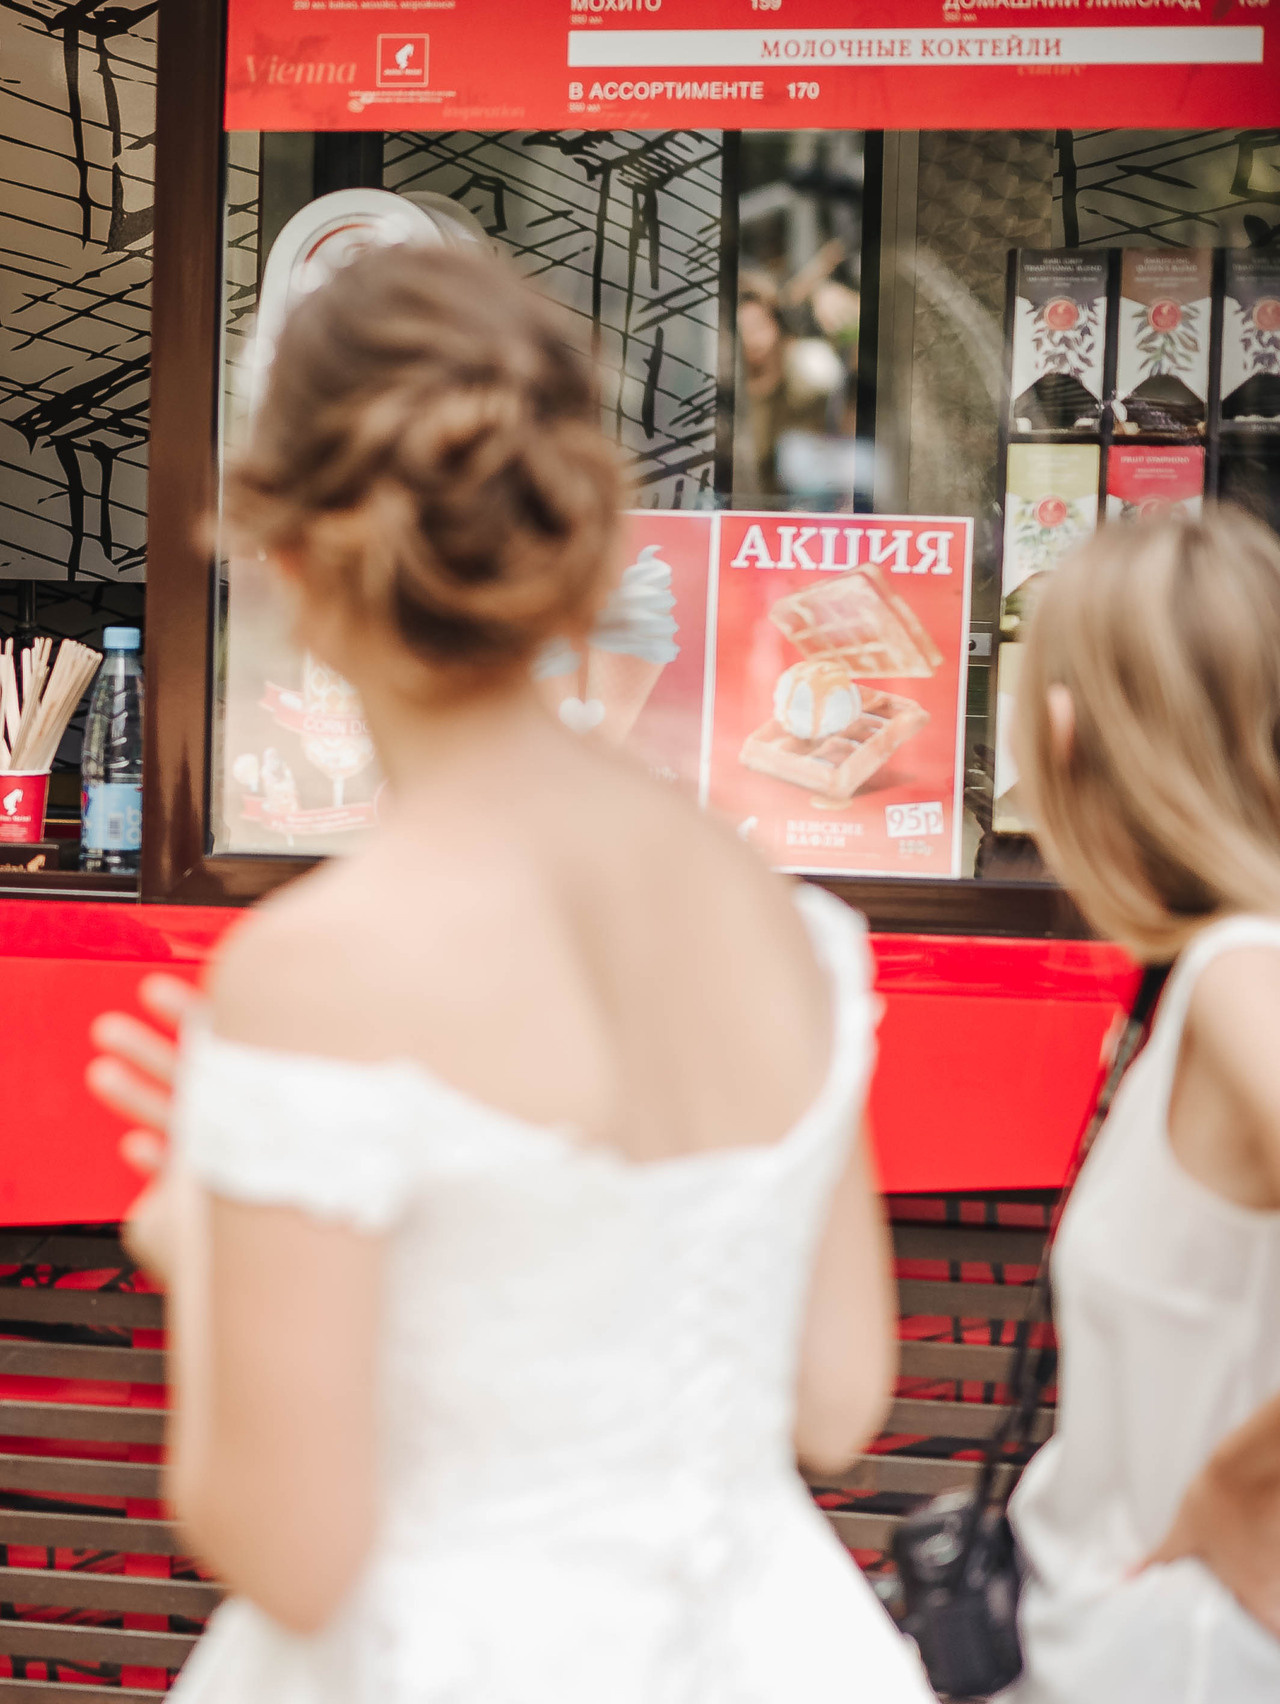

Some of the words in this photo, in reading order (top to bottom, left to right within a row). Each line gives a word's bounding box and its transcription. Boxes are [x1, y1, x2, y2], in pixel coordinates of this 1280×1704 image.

[760, 39, 912, 59] МОЛОЧНЫЕ
[920, 34, 1063, 57] КОКТЕЙЛИ
[245, 54, 357, 84] Vienna
[568, 82, 584, 100] В
[588, 80, 765, 100] АССОРТИМЕНТЕ
[787, 81, 820, 100] 170
[730, 524, 954, 575] АКЦИЯ
